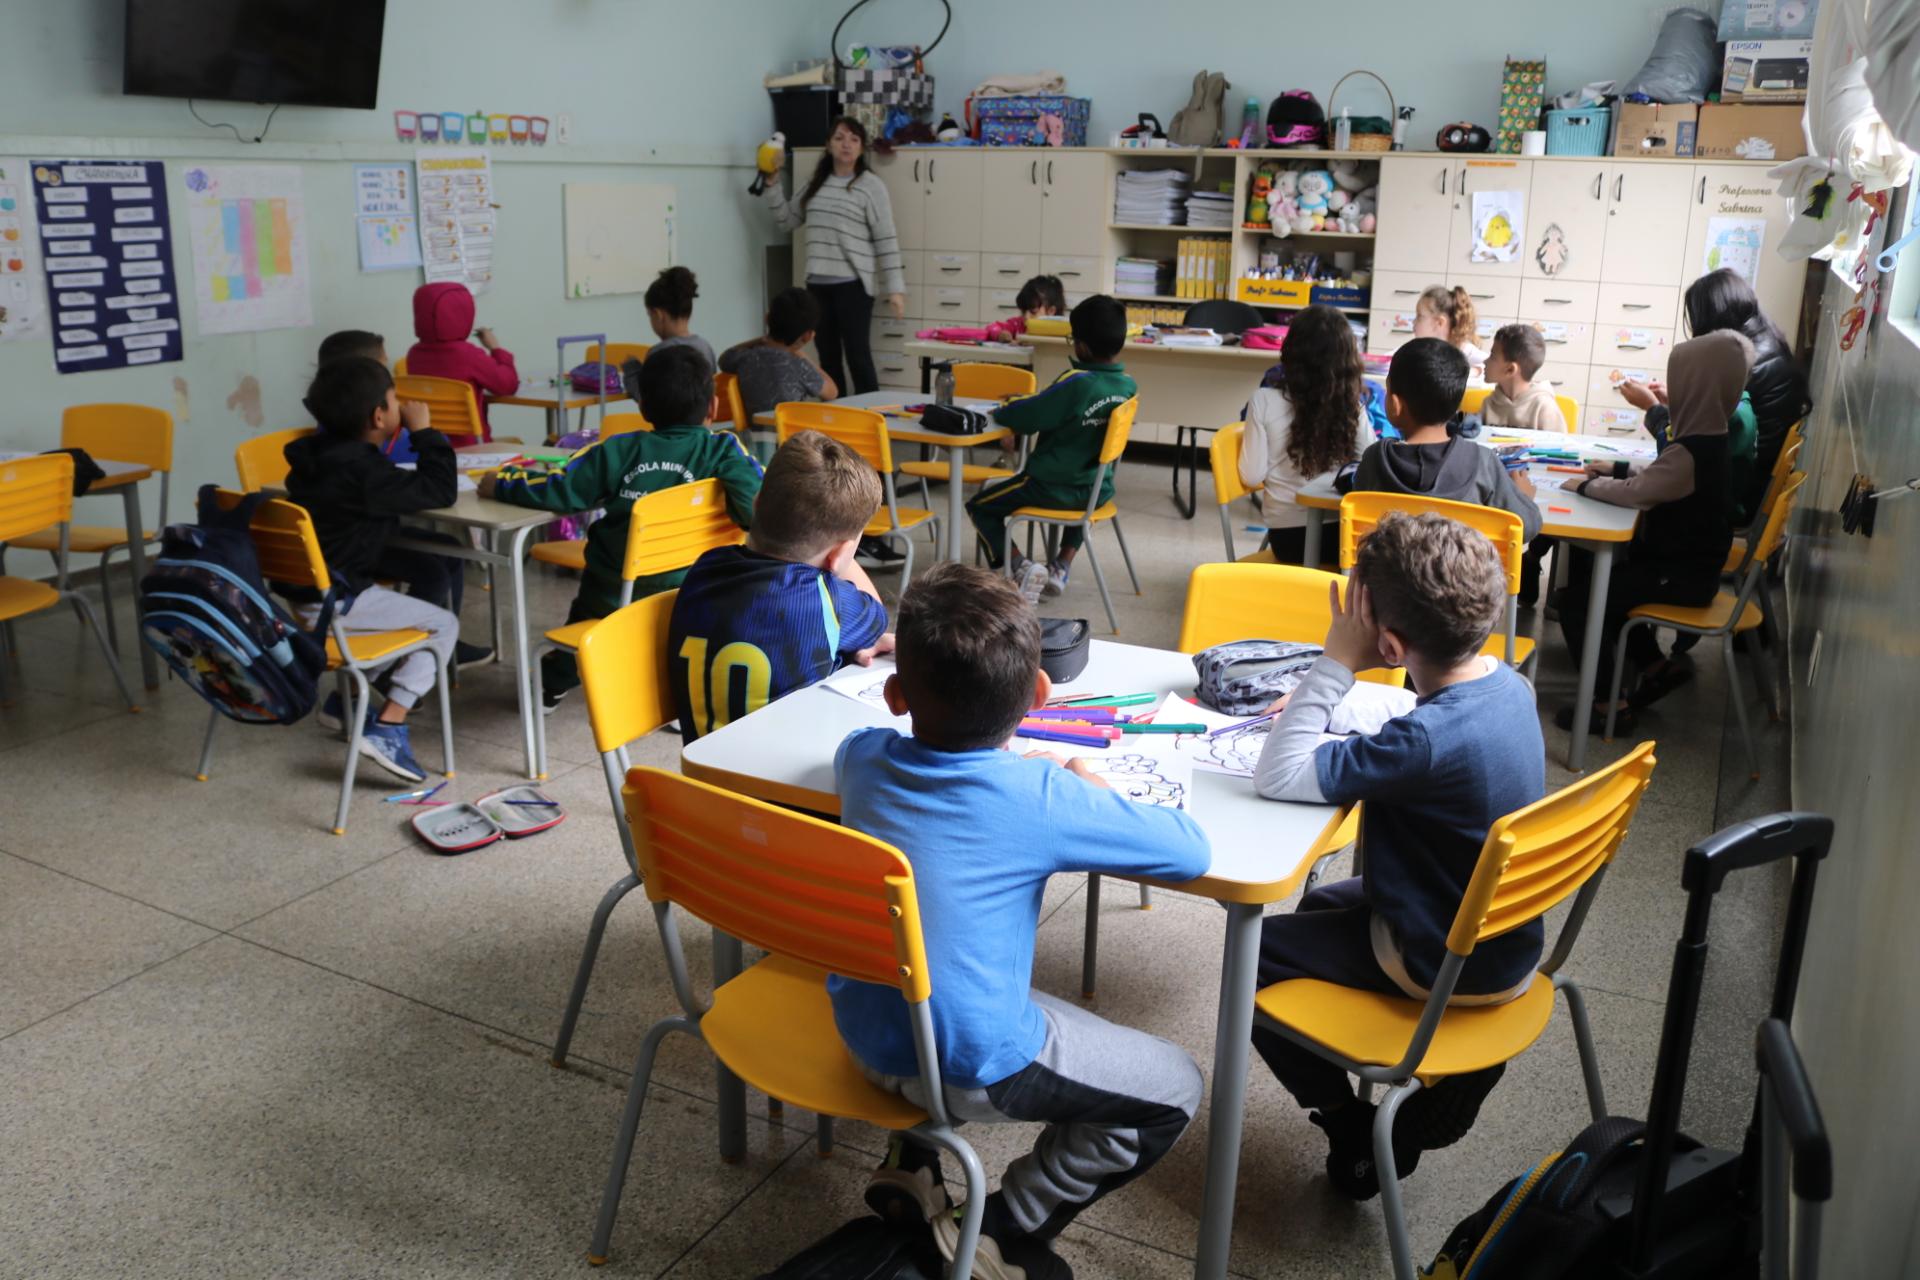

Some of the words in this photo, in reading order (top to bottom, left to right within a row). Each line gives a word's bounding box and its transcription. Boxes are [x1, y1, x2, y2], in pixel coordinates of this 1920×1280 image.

[1731, 42, 1762, 51] EPSON
[1677, 144, 1690, 153] A4
[1718, 184, 1773, 197] Professora
[1717, 202, 1763, 214] Sabrina
[1084, 396, 1111, 417] ESCOLA
[679, 636, 771, 738] 10
